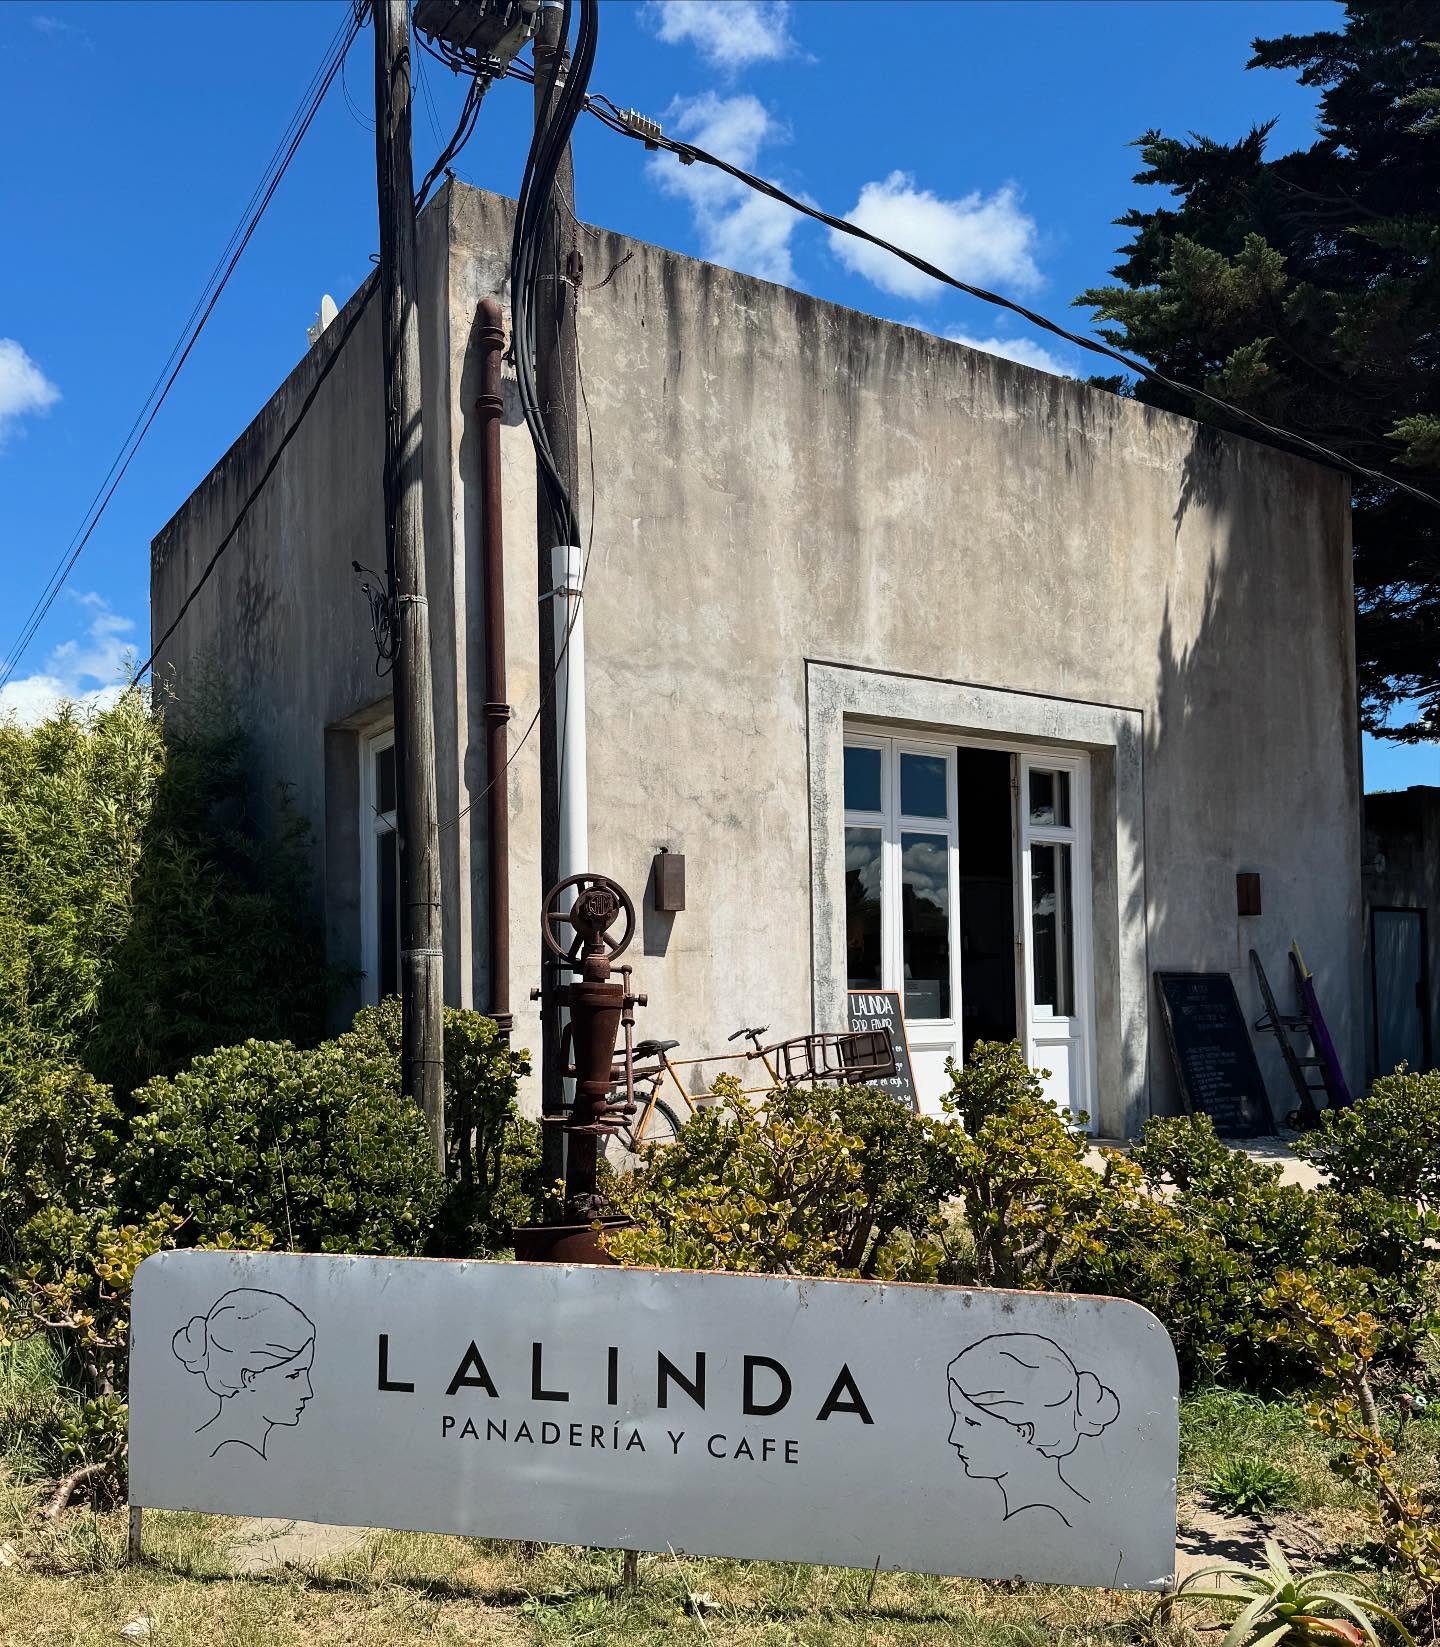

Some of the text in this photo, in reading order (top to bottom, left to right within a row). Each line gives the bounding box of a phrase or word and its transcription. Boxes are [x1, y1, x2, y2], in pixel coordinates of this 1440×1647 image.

[851, 995, 894, 1015] LALINDA
[377, 1333, 875, 1425] LALINDA
[441, 1415, 800, 1464] PANADERÍA Y CAFE
